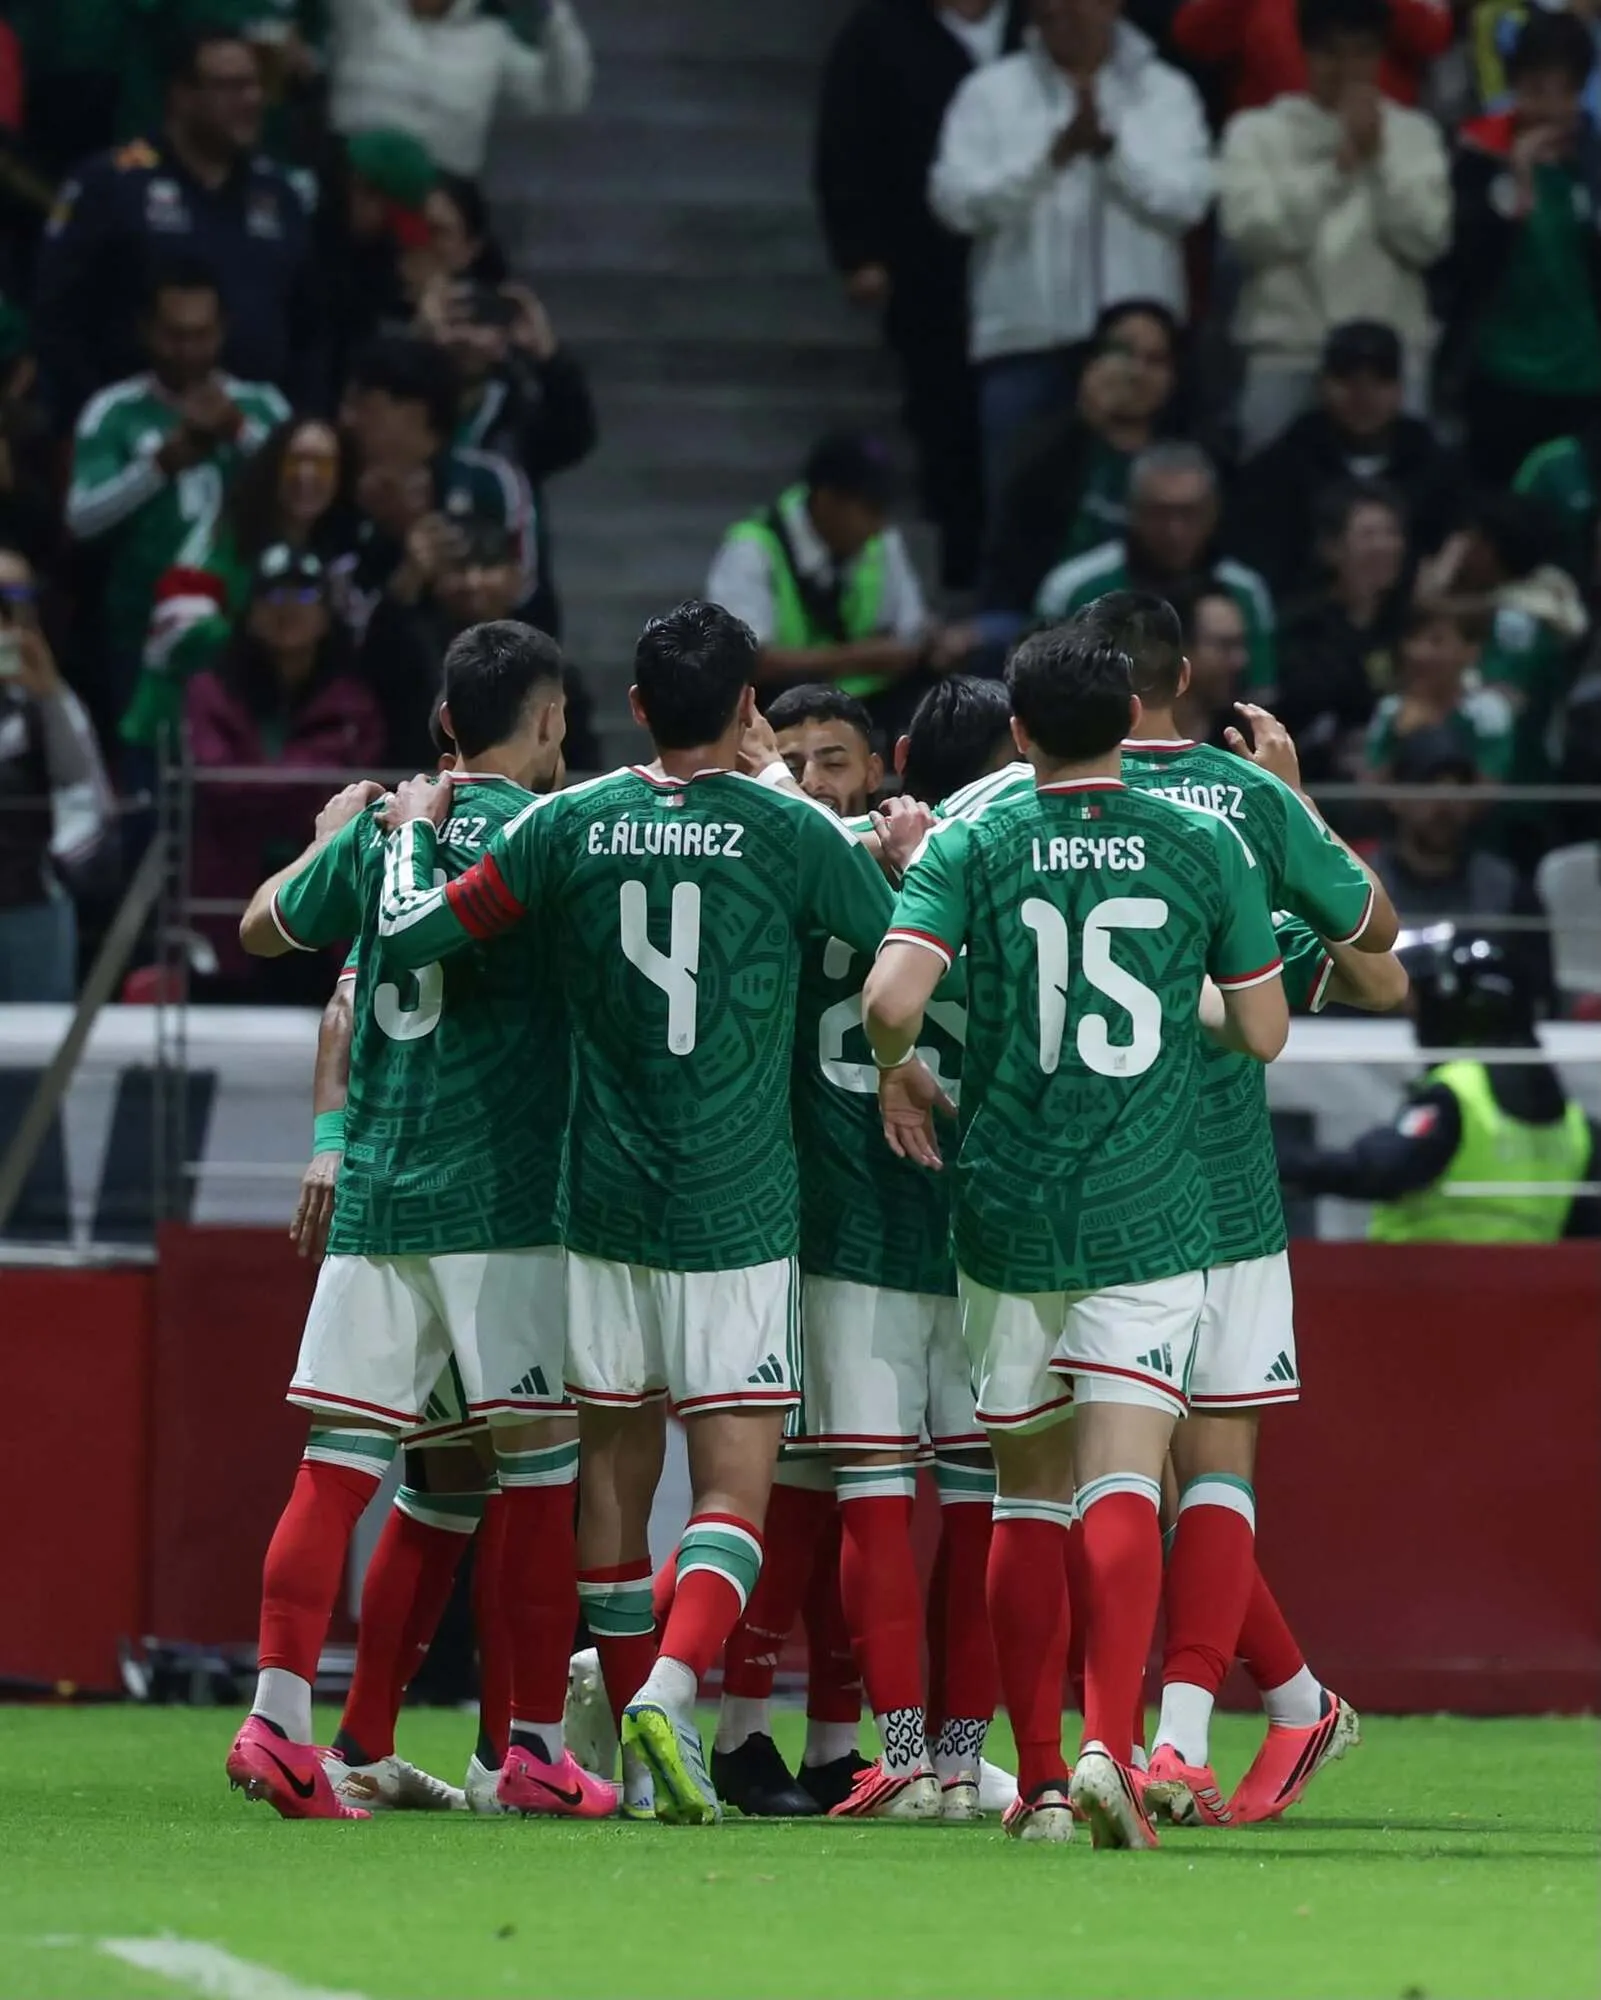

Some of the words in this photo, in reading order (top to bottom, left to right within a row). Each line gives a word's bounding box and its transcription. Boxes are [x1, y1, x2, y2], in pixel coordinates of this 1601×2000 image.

[588, 812, 744, 858] E.ÁLVAREZ
[1032, 835, 1146, 872] I.REYES
[619, 879, 701, 1056] 4
[1021, 897, 1169, 1077] 15
